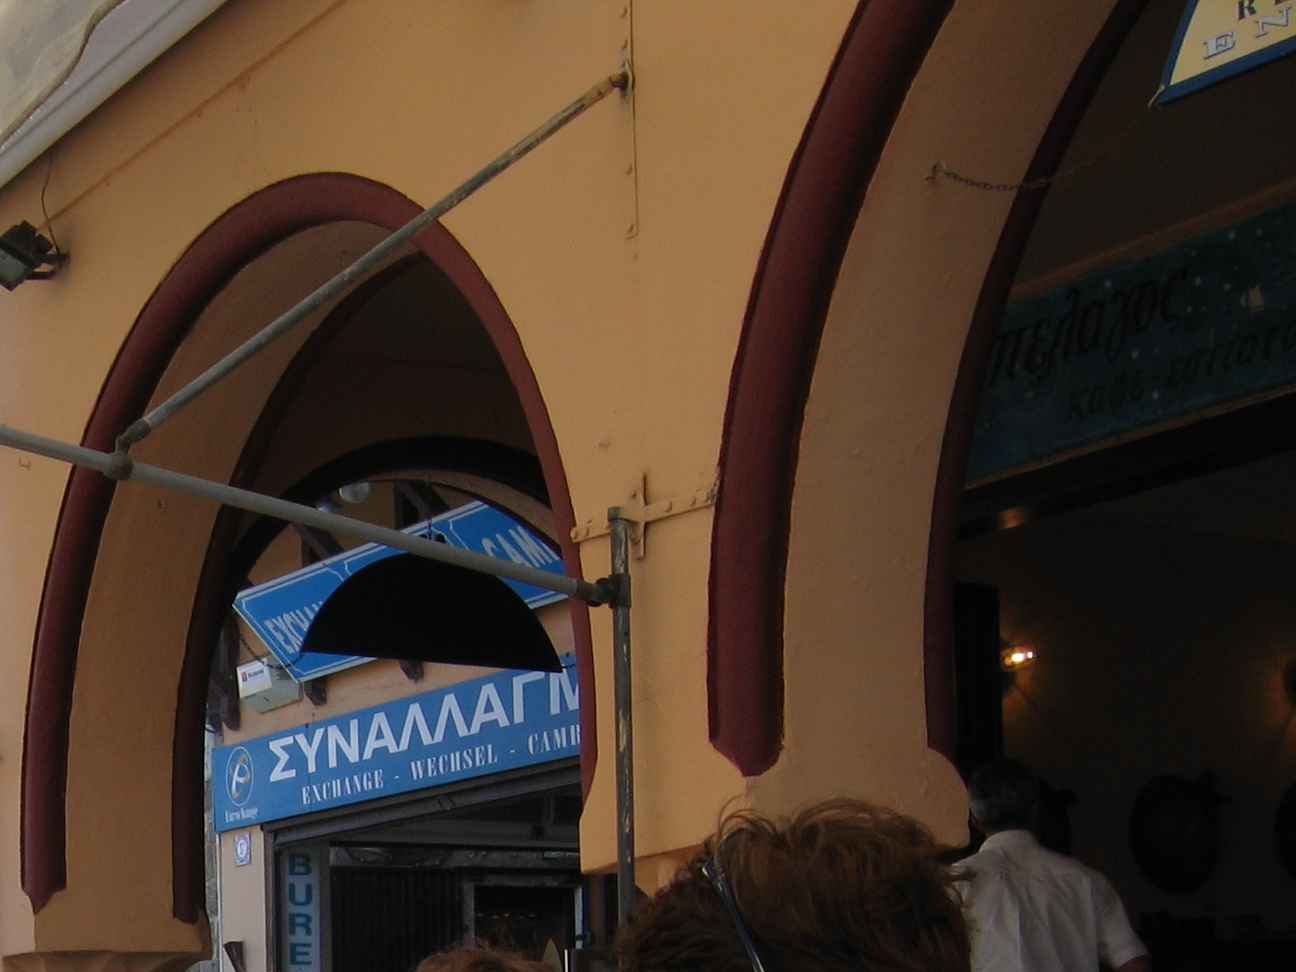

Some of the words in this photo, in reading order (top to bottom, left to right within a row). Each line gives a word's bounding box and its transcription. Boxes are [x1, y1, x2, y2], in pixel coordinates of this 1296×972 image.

[481, 526, 561, 568] CAM
[301, 768, 385, 805] EXCHANGE
[410, 743, 498, 781] WECHSEL
